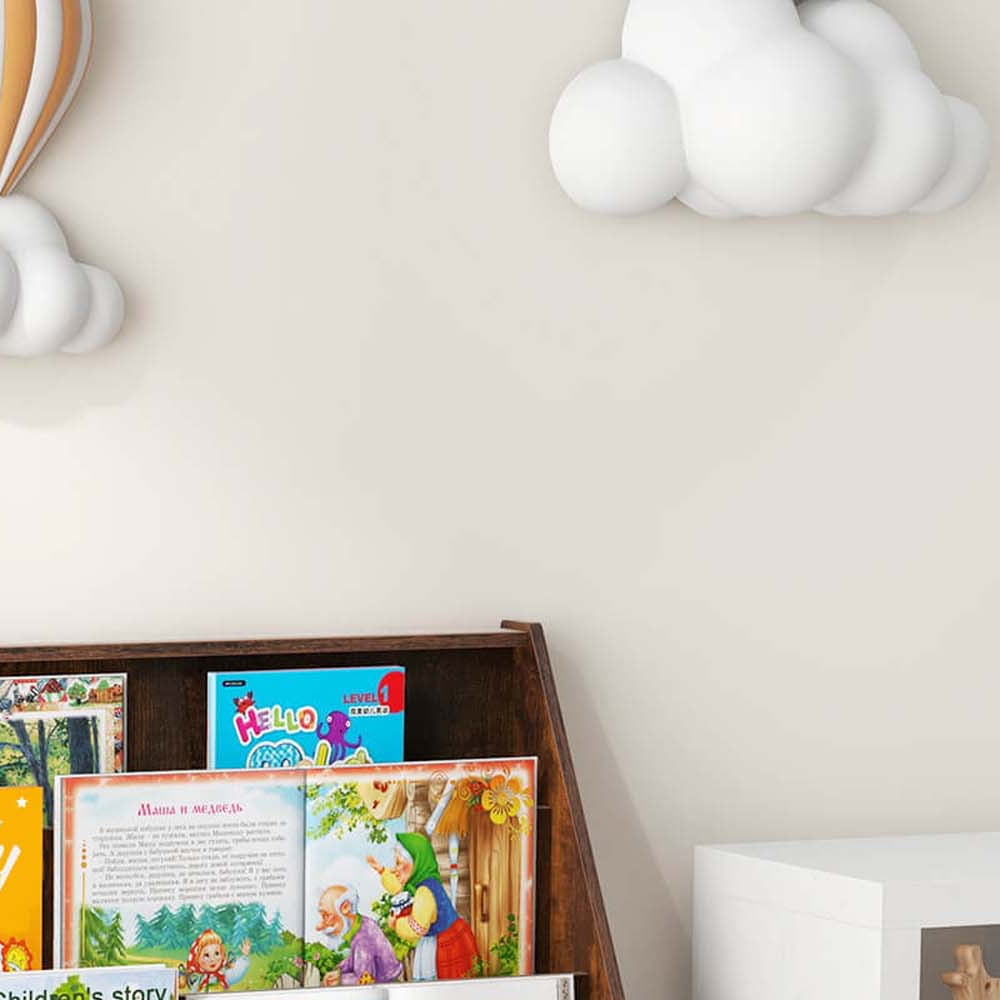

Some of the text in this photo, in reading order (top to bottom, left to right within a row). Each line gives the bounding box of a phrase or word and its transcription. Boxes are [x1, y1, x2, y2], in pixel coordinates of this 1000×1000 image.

[343, 685, 389, 704] LEVEL 1
[235, 708, 316, 743] HELLO
[137, 803, 176, 816] Маша
